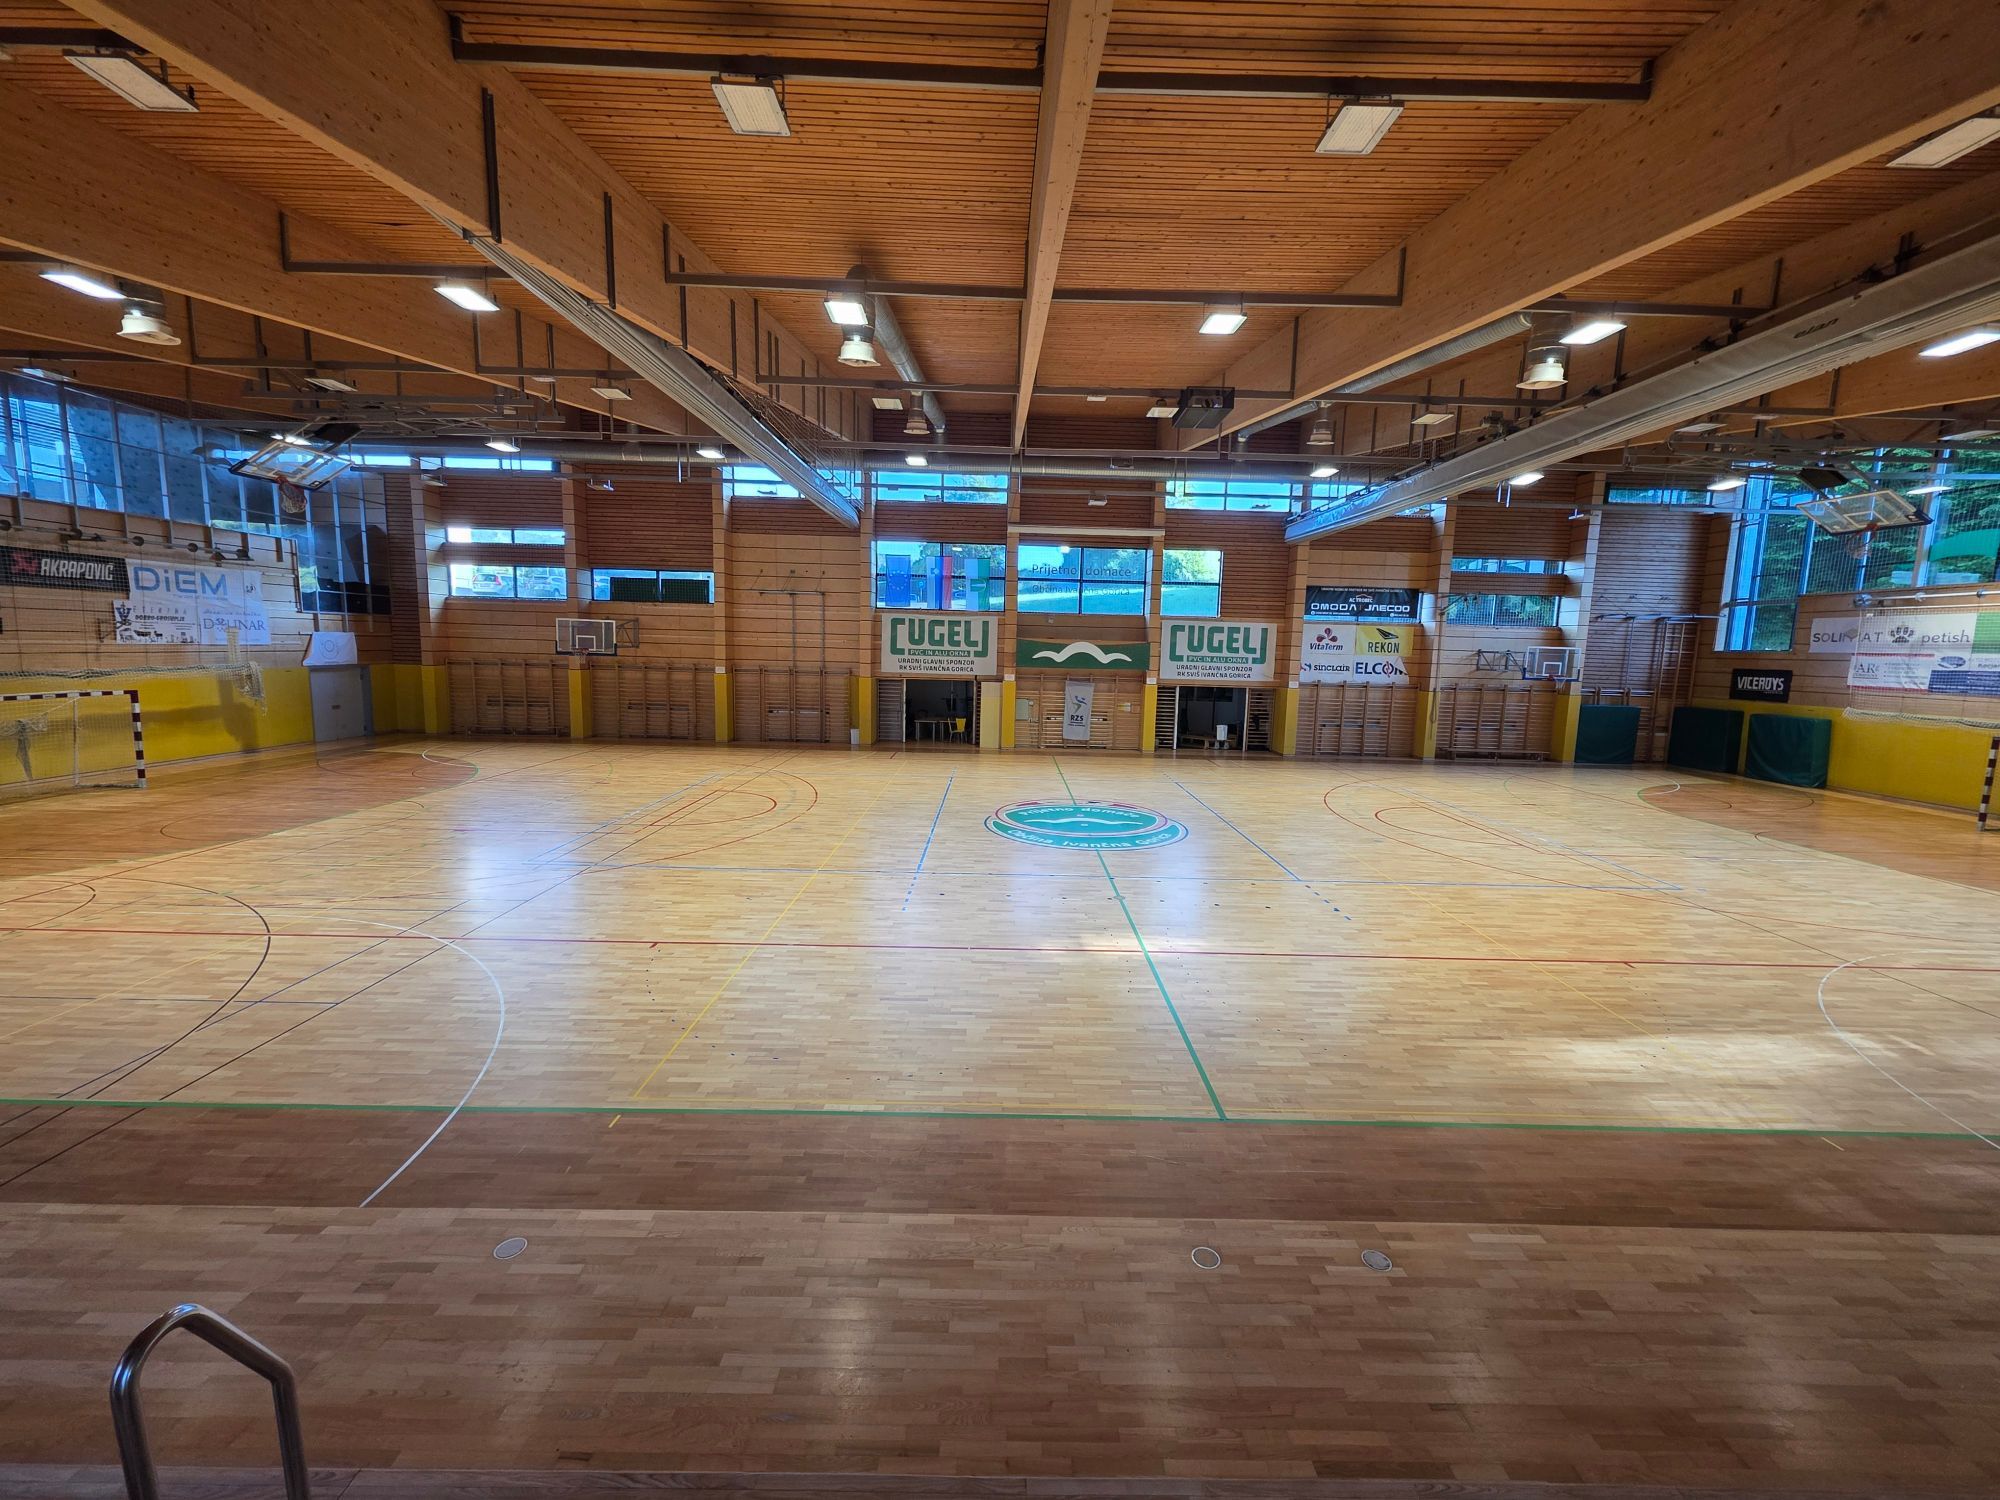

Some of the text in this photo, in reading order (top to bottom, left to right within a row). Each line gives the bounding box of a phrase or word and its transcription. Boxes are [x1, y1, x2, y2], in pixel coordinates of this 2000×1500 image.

[1032, 564, 1077, 576] Prijetno
[1311, 603, 1410, 612] OMODA JAECOO
[890, 617, 990, 658] CUGELJ
[1920, 629, 1971, 644] petish
[1169, 624, 1269, 665] CUGELJ
[1309, 642, 1343, 651] VitaTerm
[1367, 641, 1400, 653] REKON
[923, 664, 950, 672] IVANČNA
[1313, 663, 1350, 672] sinclair
[1737, 676, 1785, 690] VICEROYS
